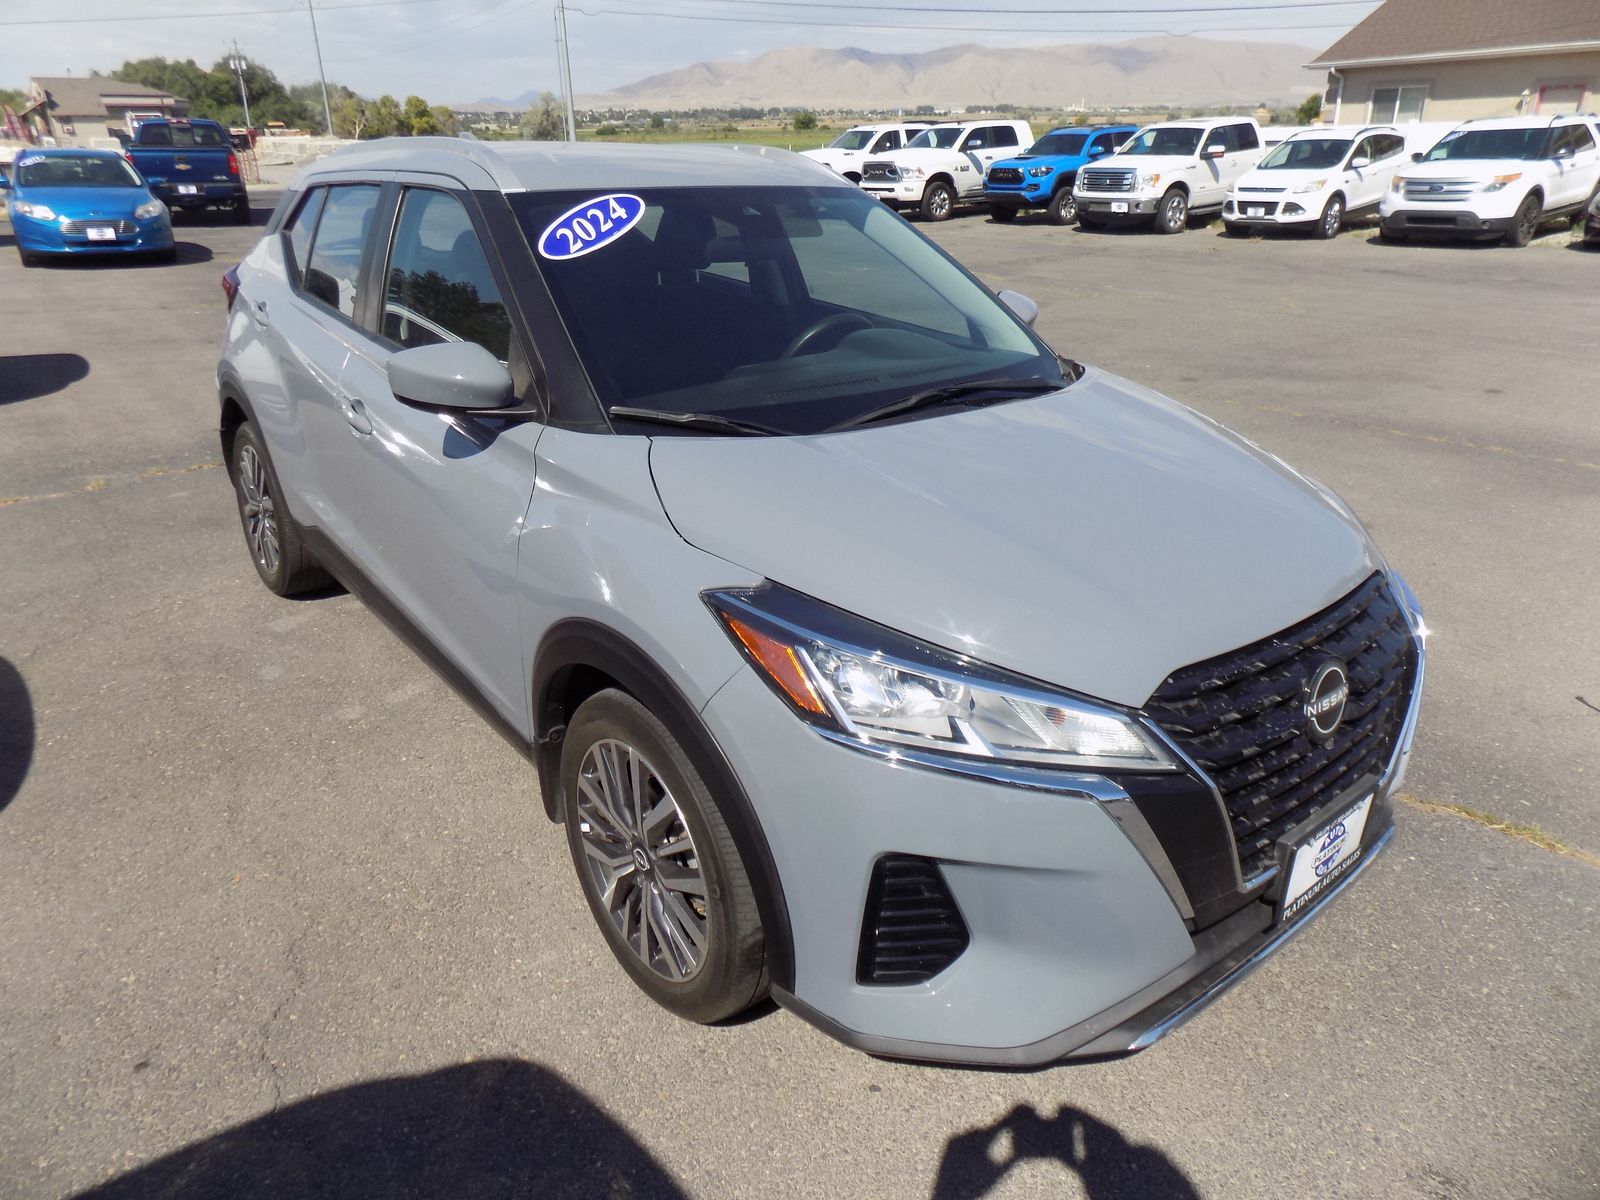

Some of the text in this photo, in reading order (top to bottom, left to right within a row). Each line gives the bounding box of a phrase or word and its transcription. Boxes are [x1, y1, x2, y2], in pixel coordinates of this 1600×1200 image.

[556, 197, 628, 254] 2024
[1305, 683, 1349, 717] NISSAN
[1325, 825, 1345, 847] AUTO
[1282, 848, 1361, 921] PLATINUM AUTO SALES
